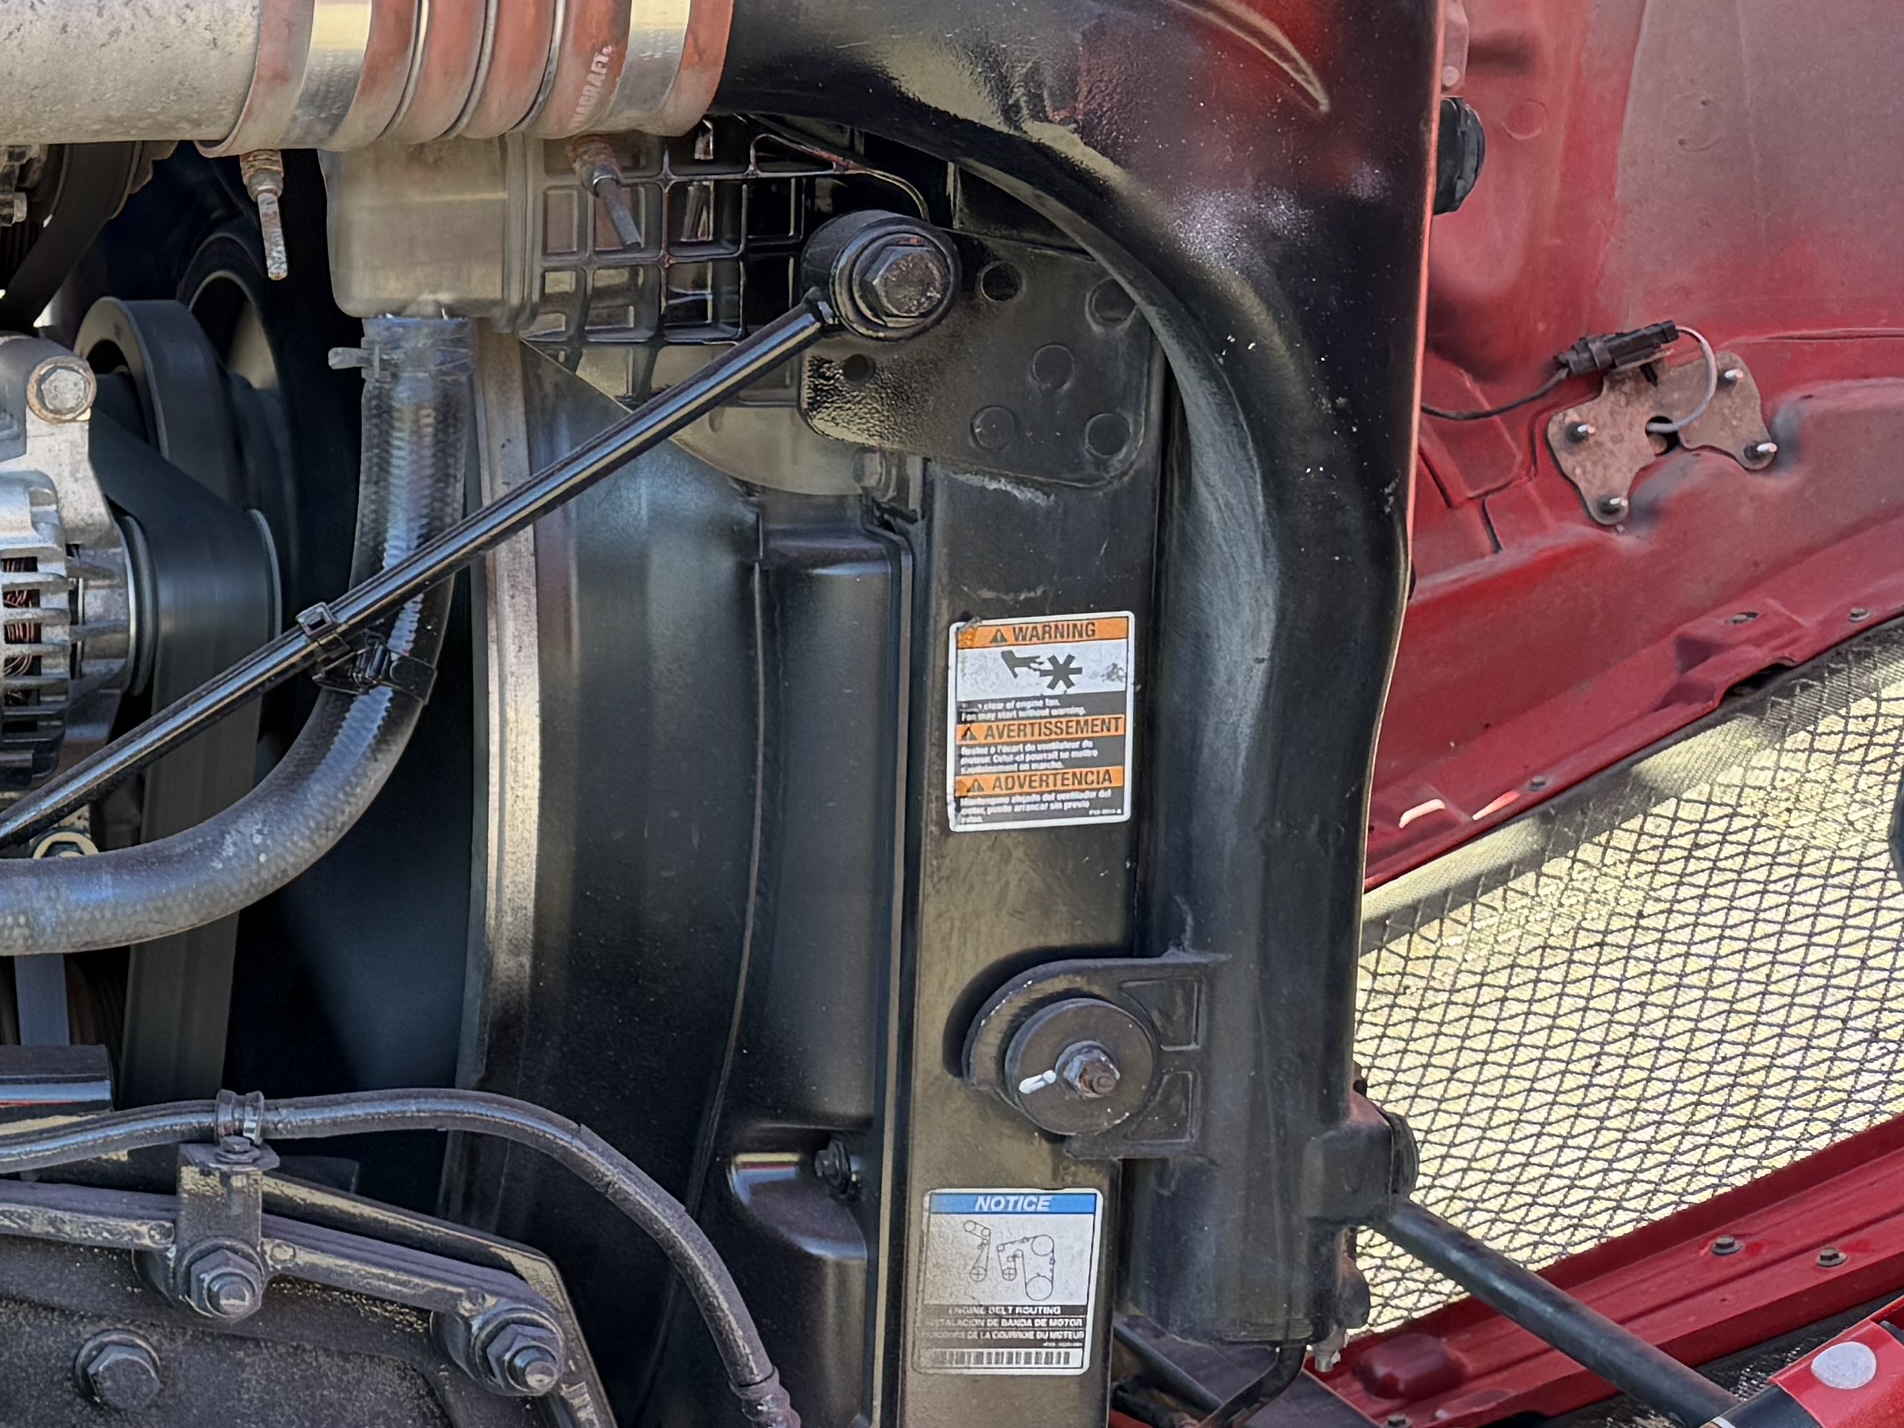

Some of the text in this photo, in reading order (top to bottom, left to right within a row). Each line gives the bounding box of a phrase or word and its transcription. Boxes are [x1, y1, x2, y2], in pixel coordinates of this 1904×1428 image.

[1012, 622, 1096, 642] WARNING
[984, 701, 1004, 711] clear
[1006, 700, 1014, 709] of
[984, 716, 1123, 740] AVERTISSEMENT
[992, 769, 1113, 792] ADVERTENCIA
[975, 1195, 1053, 1212] NOTICE
[948, 1305, 1060, 1315] ENGINE BELT ROUTING
[987, 1318, 1082, 1327] DE BANDA DE MOTOR
[980, 1330, 1084, 1339] LA DU MOTEUR
